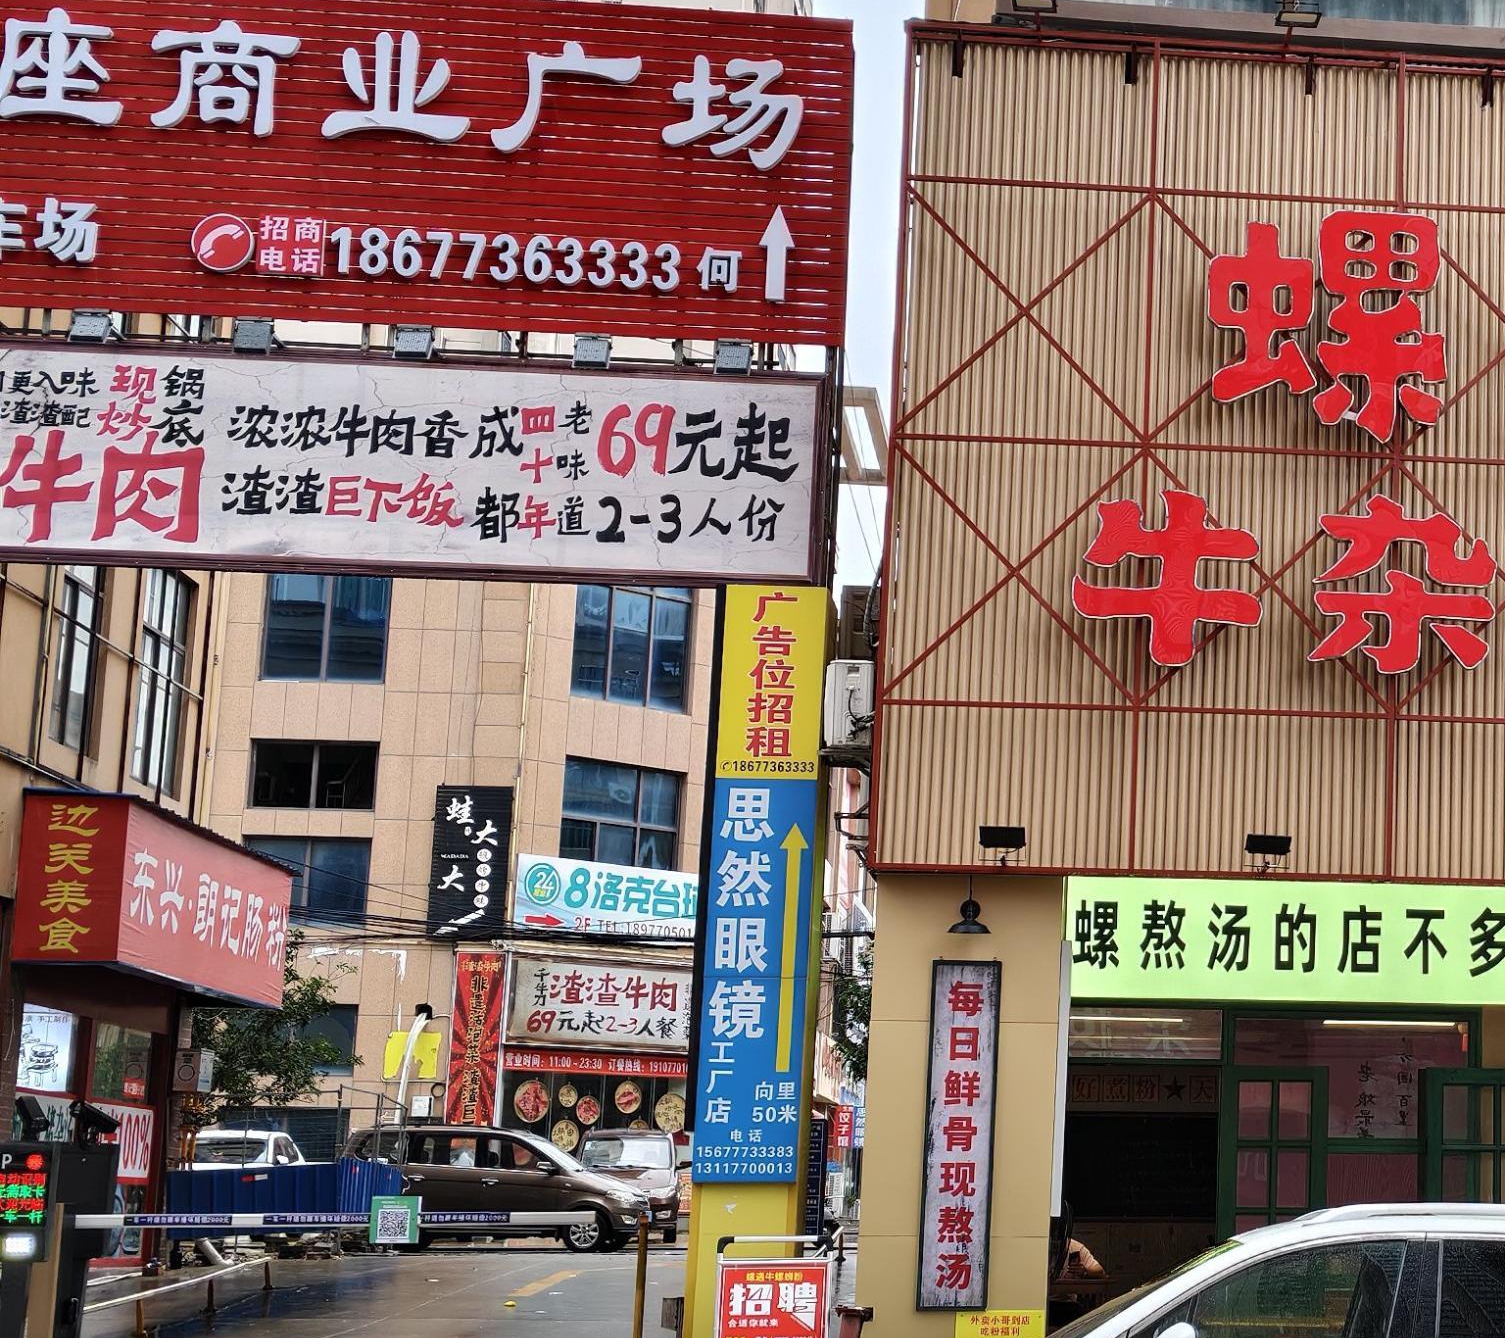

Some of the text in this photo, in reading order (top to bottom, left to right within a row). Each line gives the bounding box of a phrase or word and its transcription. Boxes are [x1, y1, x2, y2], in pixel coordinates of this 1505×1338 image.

[0, 8, 804, 171] 座商业广场
[259, 215, 322, 242] 招商
[259, 249, 322, 273] 电话
[330, 225, 742, 294] 18677363333 何
[0, 366, 99, 397] 更入味
[597, 402, 799, 482] 69元起
[1, 428, 206, 543] 牛肉
[597, 494, 786, 544] 2-3人份
[746, 591, 798, 758] 广告位招租
[732, 760, 815, 773] 18677363333
[708, 787, 774, 1039] 思然眼镜
[550, 969, 679, 1012] 渣渣牛肉
[461, 1067, 481, 1124] 渣渣巨
[704, 1042, 736, 1124] 工厂店
[754, 1081, 797, 1102] 向里
[730, 1129, 763, 1143] 电话
[752, 1105, 798, 1125] 50米
[935, 980, 985, 1291] 每日鲜骨现熬汤
[695, 1162, 794, 1176] 13117700013
[696, 1145, 795, 1159] 15677733383
[729, 1282, 818, 1330] 招聘
[970, 1315, 1030, 1326] 外卖小哥到店
[980, 1326, 1020, 1336] 吃粉福利
